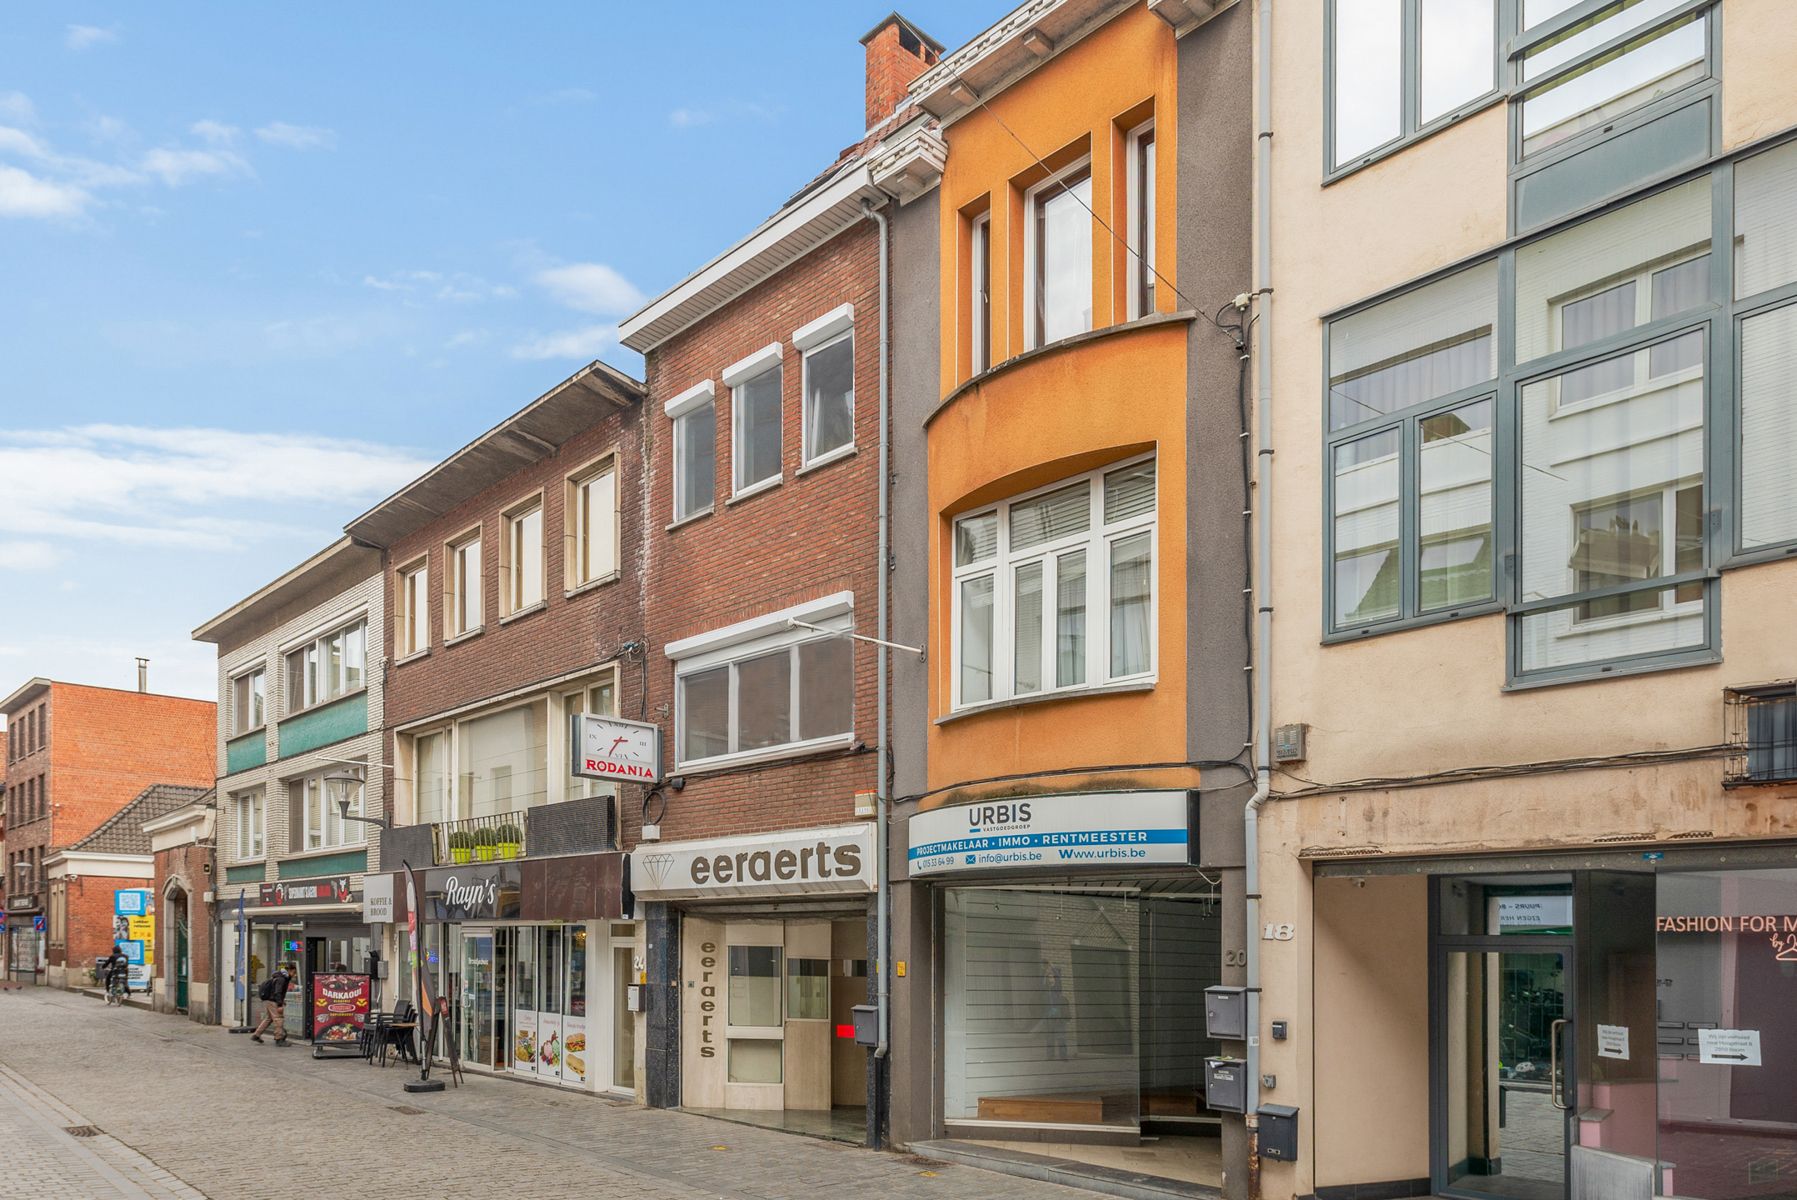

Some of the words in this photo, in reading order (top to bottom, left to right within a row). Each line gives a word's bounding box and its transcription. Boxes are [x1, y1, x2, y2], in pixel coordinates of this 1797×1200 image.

[586, 759, 653, 778] RODANIA
[969, 803, 1031, 826] URBIS
[983, 824, 1031, 832] VASTGOEDGROEP
[916, 839, 989, 856] PROJECTMAKELAAR
[998, 836, 1030, 847] IMMO
[1042, 831, 1148, 845] RENTMEESTER
[978, 851, 1042, 864] info@urbis.be
[1058, 847, 1146, 859] Www.urbis.be
[690, 841, 862, 885] eeraerts
[370, 897, 387, 906] KOFFIE
[445, 876, 496, 911] Rayn's
[370, 907, 387, 916] BROOD
[1262, 923, 1295, 941] 18
[1656, 916, 1733, 932] FASHION
[1740, 916, 1777, 932] FOR
[1769, 932, 1785, 952] by
[1226, 949, 1247, 967] 20
[322, 988, 362, 999] DARKAOUI
[700, 942, 716, 1058] eeraerts
